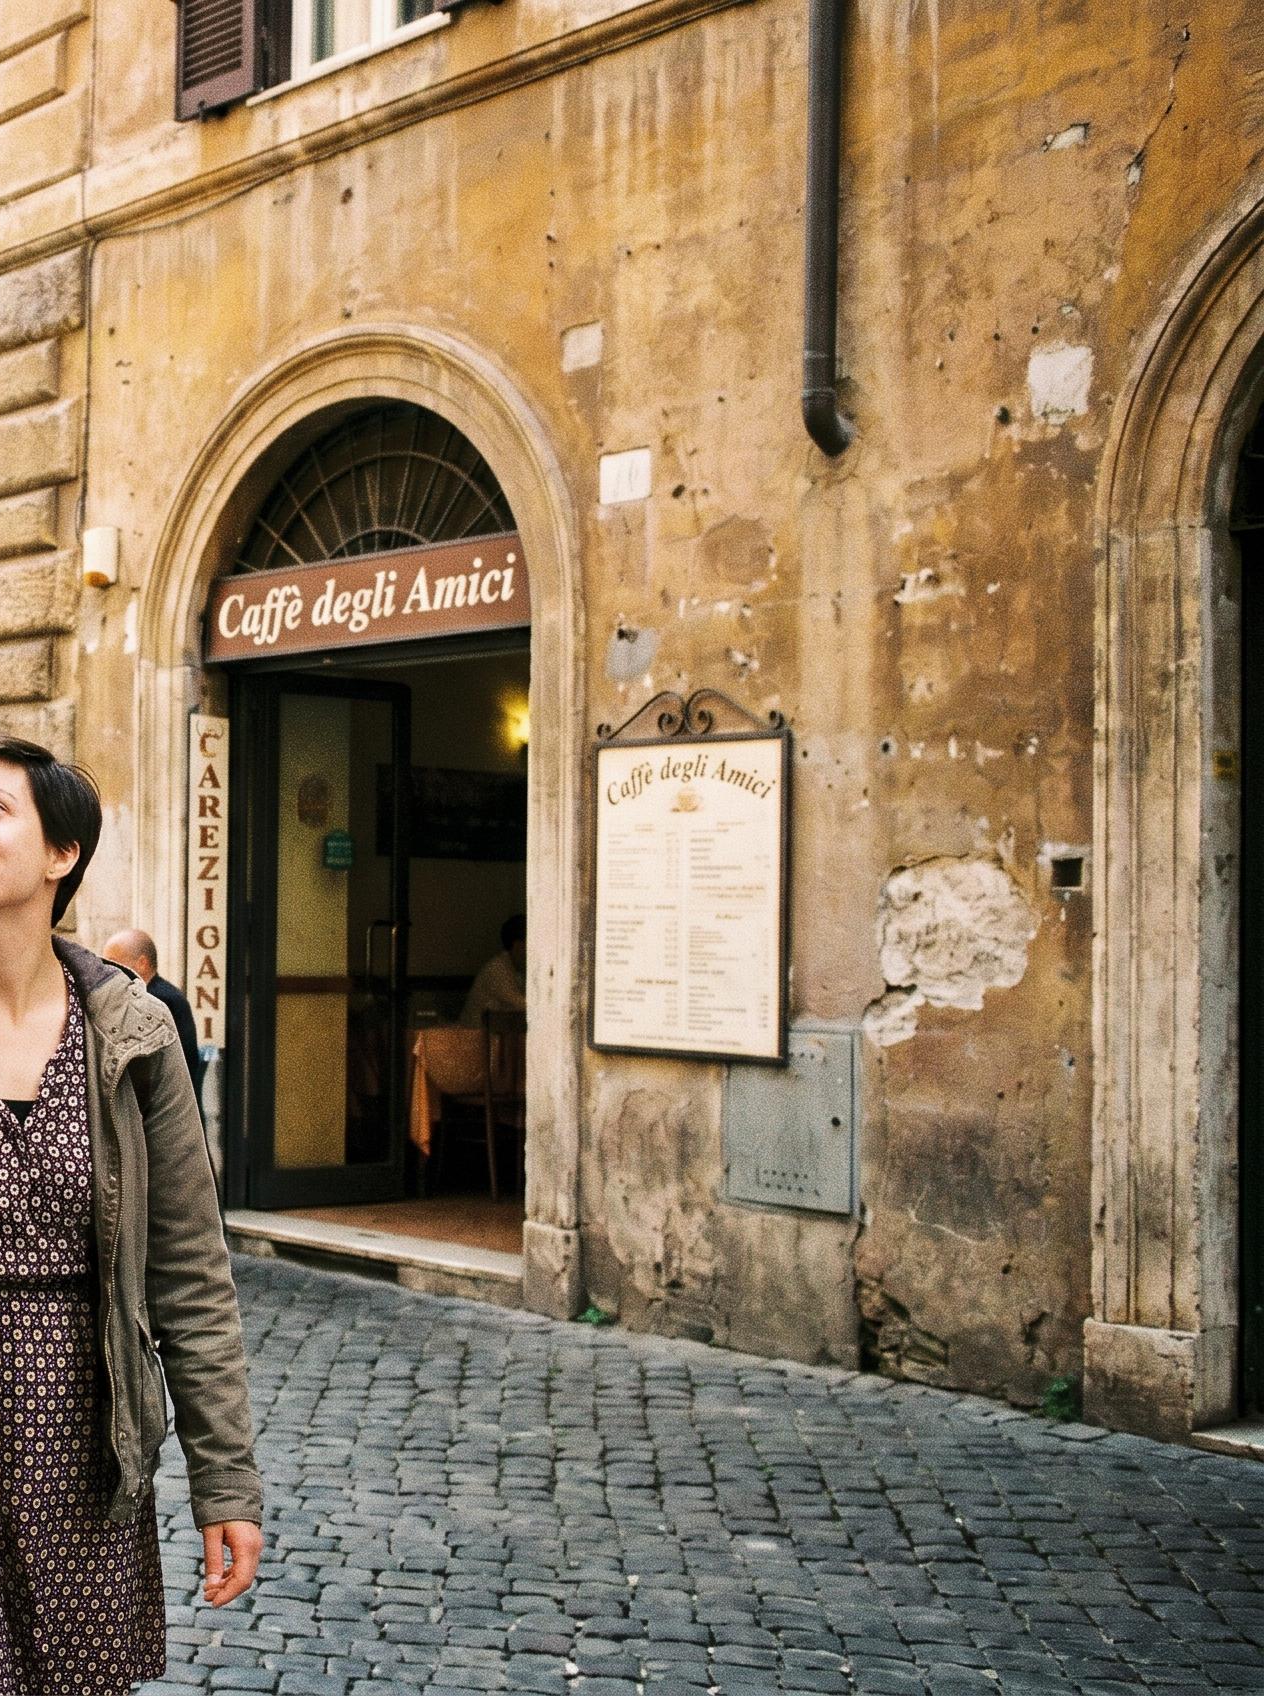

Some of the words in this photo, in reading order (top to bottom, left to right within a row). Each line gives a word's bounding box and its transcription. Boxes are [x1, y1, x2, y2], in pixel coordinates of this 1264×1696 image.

[218, 585, 301, 645] Caffè
[311, 570, 397, 633] degli
[403, 552, 516, 614] Amici
[607, 761, 653, 805] Caffè
[660, 754, 709, 783] degli
[711, 758, 776, 799] Amici
